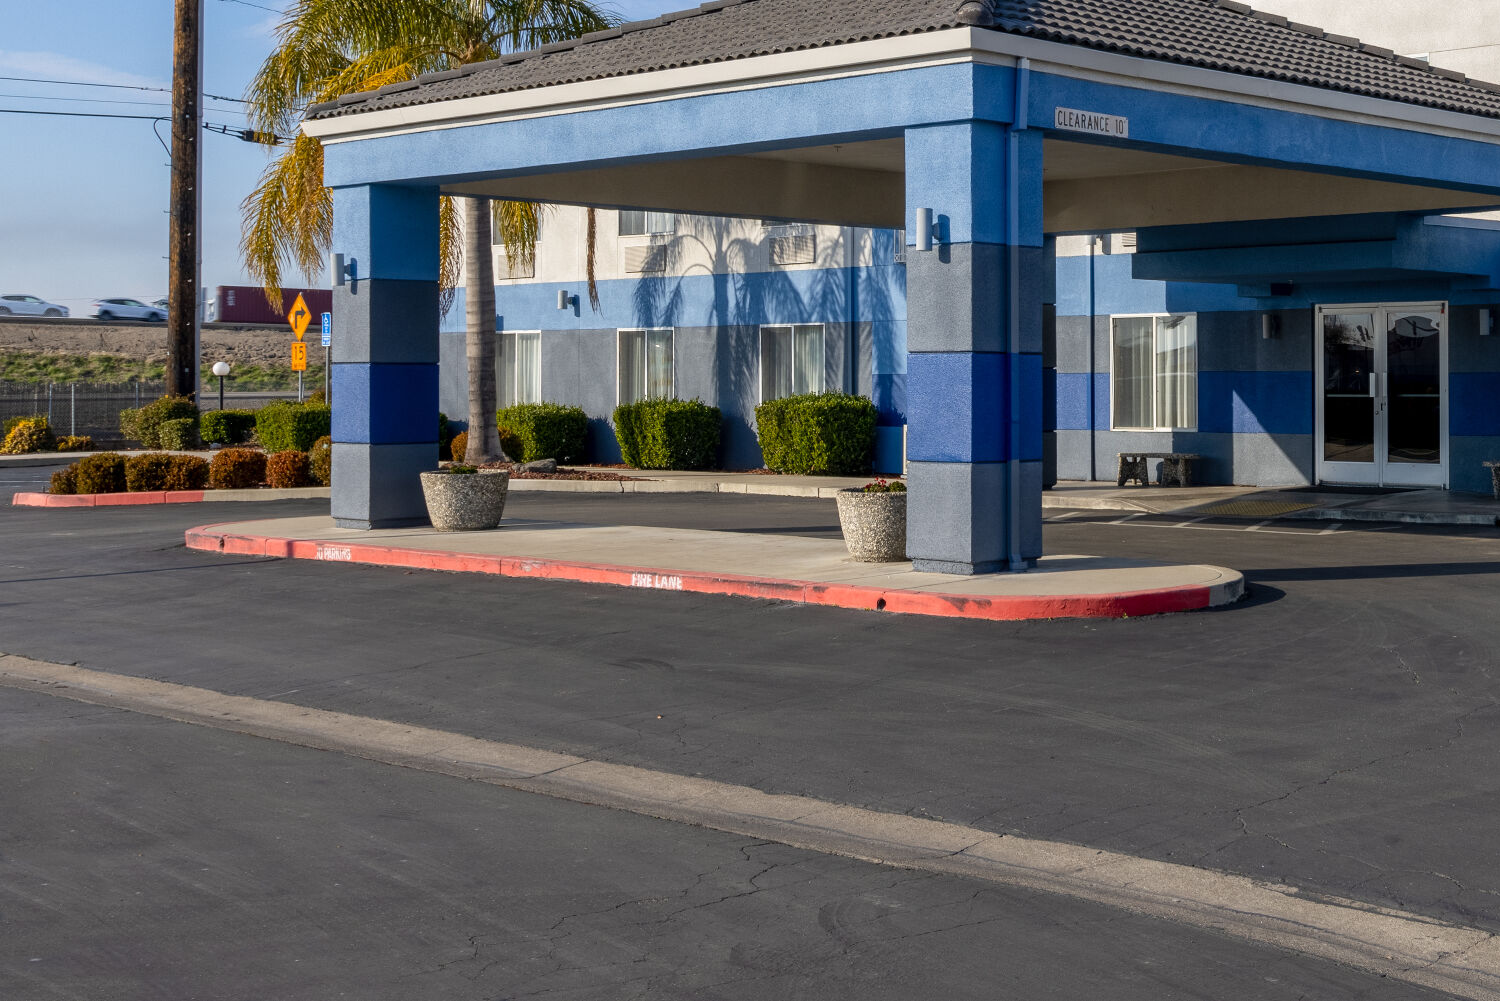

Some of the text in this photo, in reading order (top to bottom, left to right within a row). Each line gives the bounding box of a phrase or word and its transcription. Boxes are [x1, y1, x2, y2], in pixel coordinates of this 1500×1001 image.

[1057, 110, 1110, 132] CLEARANCE
[294, 346, 304, 360] 15
[655, 575, 682, 590] LANE
